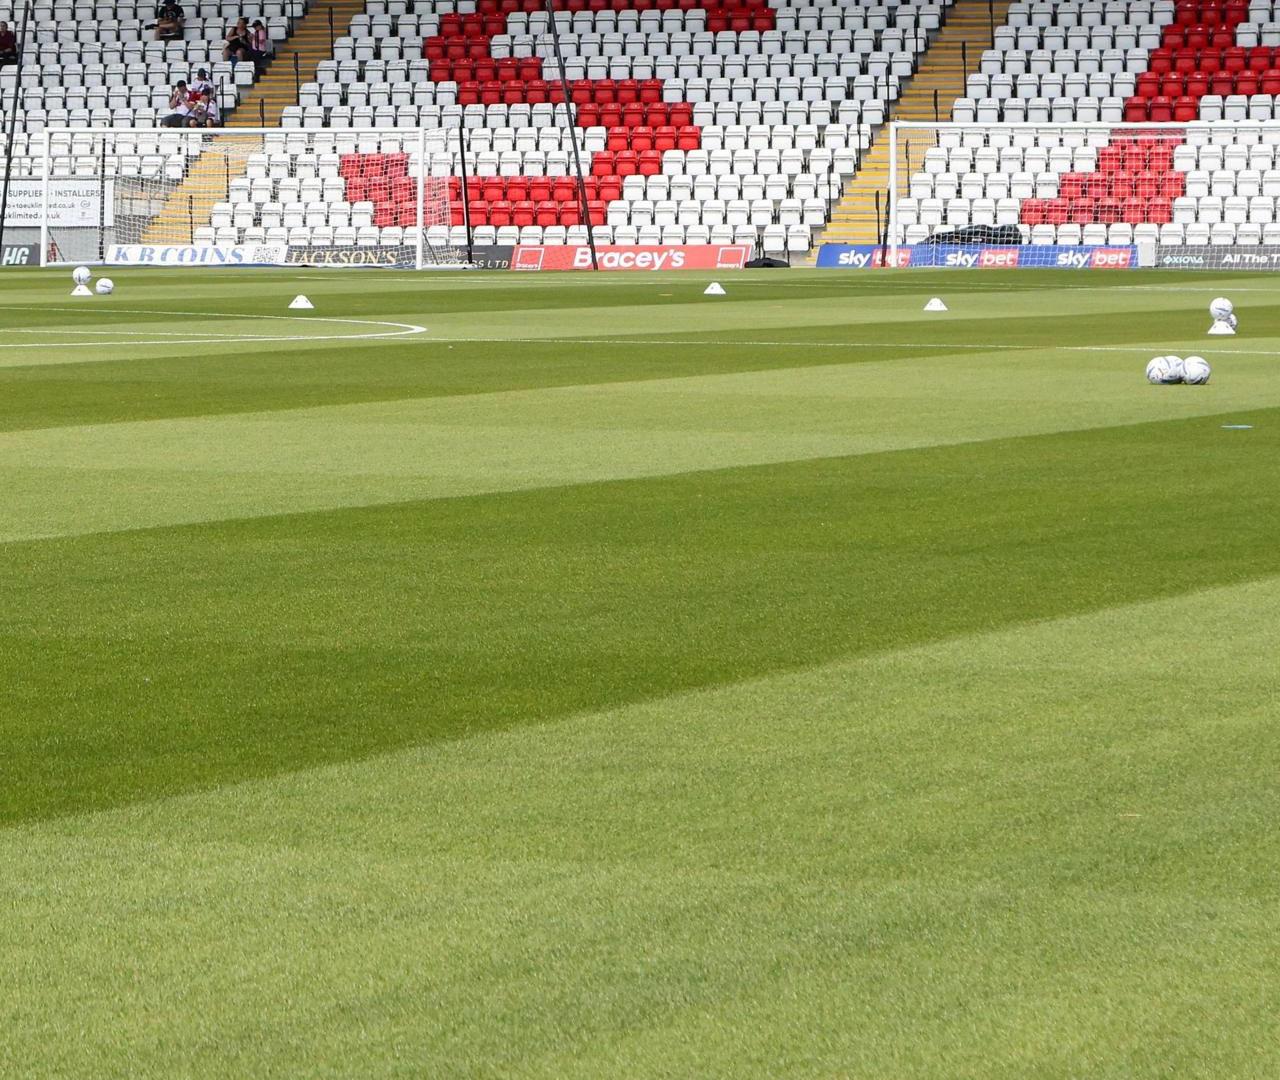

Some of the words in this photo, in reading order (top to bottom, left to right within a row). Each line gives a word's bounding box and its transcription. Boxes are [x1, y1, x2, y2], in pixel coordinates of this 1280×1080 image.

[54, 189, 101, 197] INSTALLERS
[2, 247, 30, 265] HG
[114, 246, 130, 262] K
[138, 246, 155, 262] B
[160, 246, 246, 263] COINS
[290, 250, 399, 265] JACKSON'S
[573, 247, 686, 270] Bracey's
[838, 248, 870, 268] sky
[946, 249, 978, 268] sky
[983, 251, 1015, 265] bet
[1057, 249, 1090, 268] sky
[1095, 251, 1127, 265] bet
[1222, 253, 1241, 264] All
[1243, 253, 1269, 264] The
[487, 259, 510, 268] LTD
